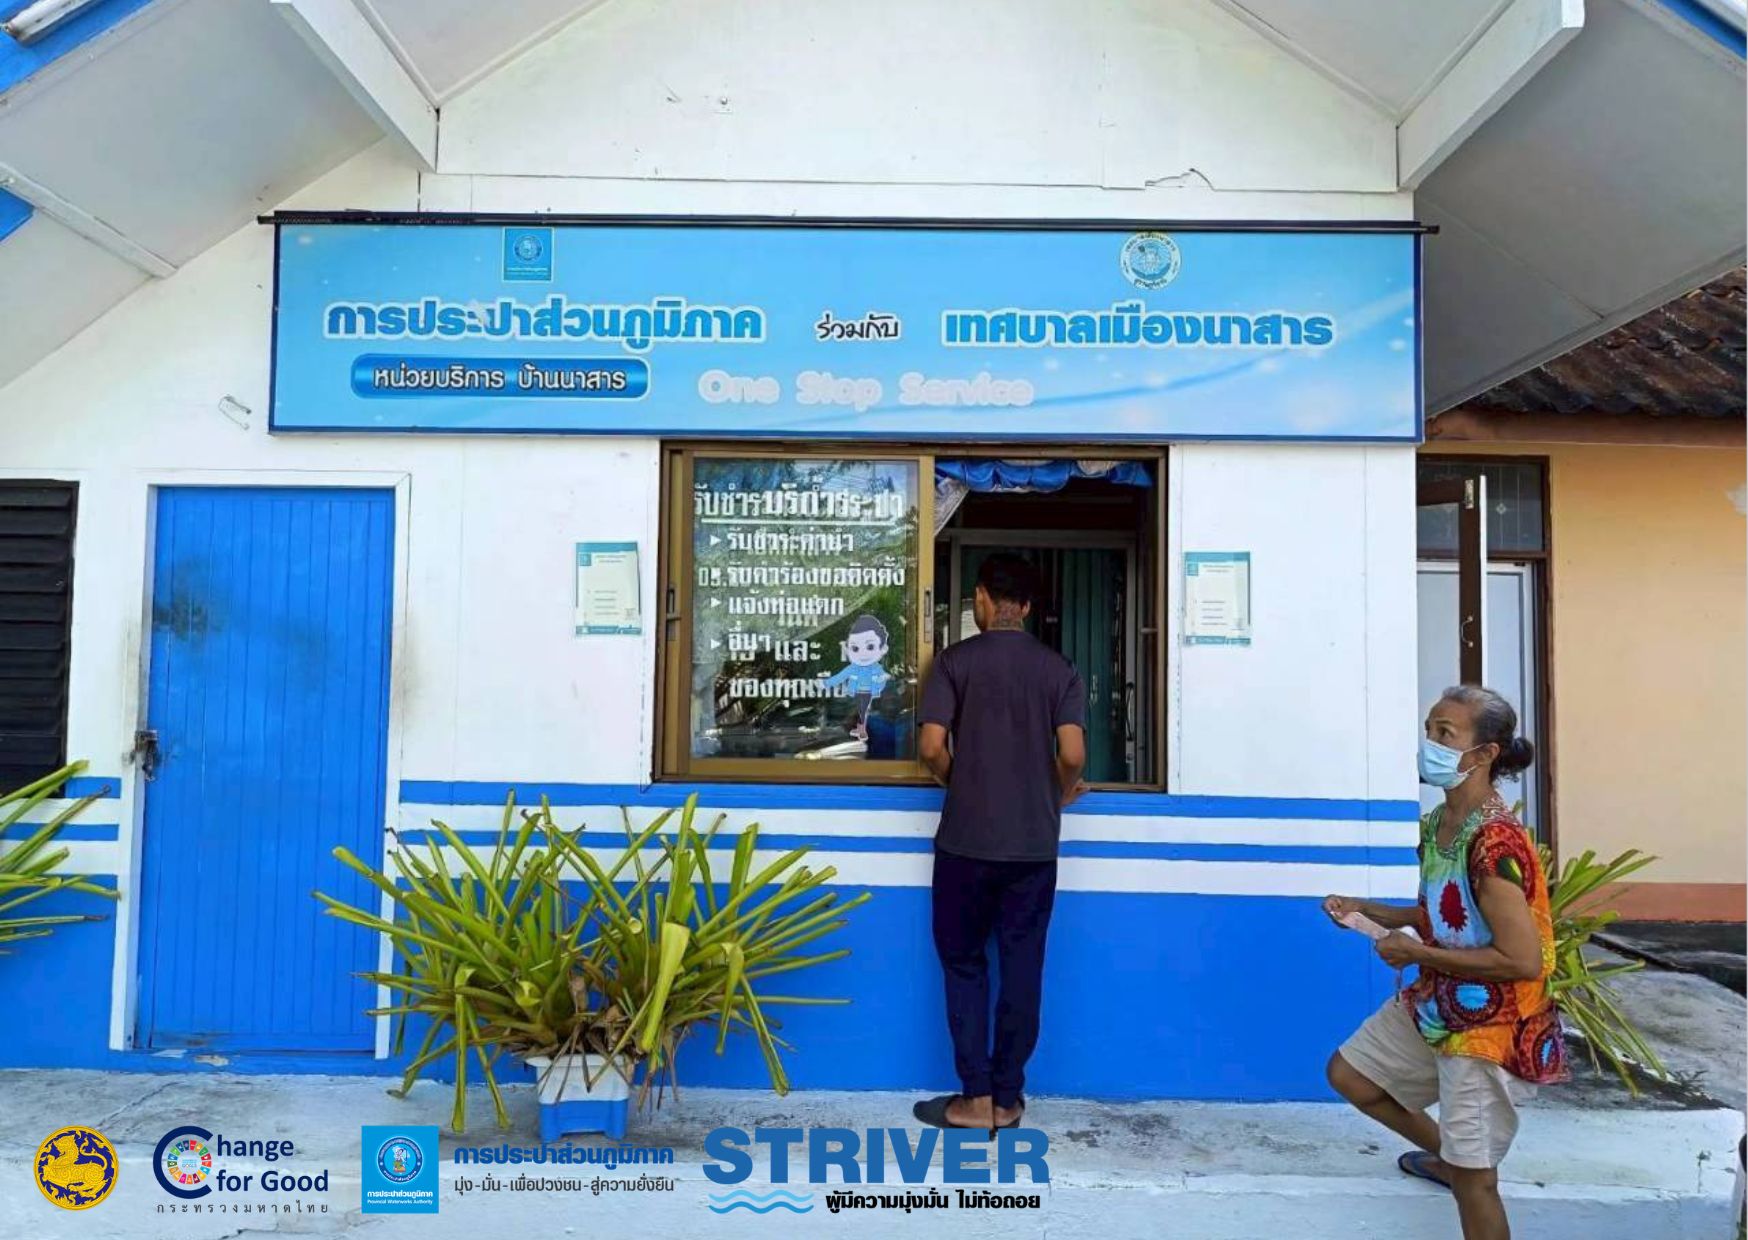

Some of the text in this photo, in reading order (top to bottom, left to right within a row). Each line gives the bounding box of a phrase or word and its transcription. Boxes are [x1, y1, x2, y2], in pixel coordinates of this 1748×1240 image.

[325, 296, 1334, 351] การประปาส่วนภูมิภาค ร่วมกับ เทศบาลเมืองนาสาร
[374, 362, 627, 391] หน่วยบริการ บ้านนาสาร
[698, 369, 1034, 412] One Stop Service
